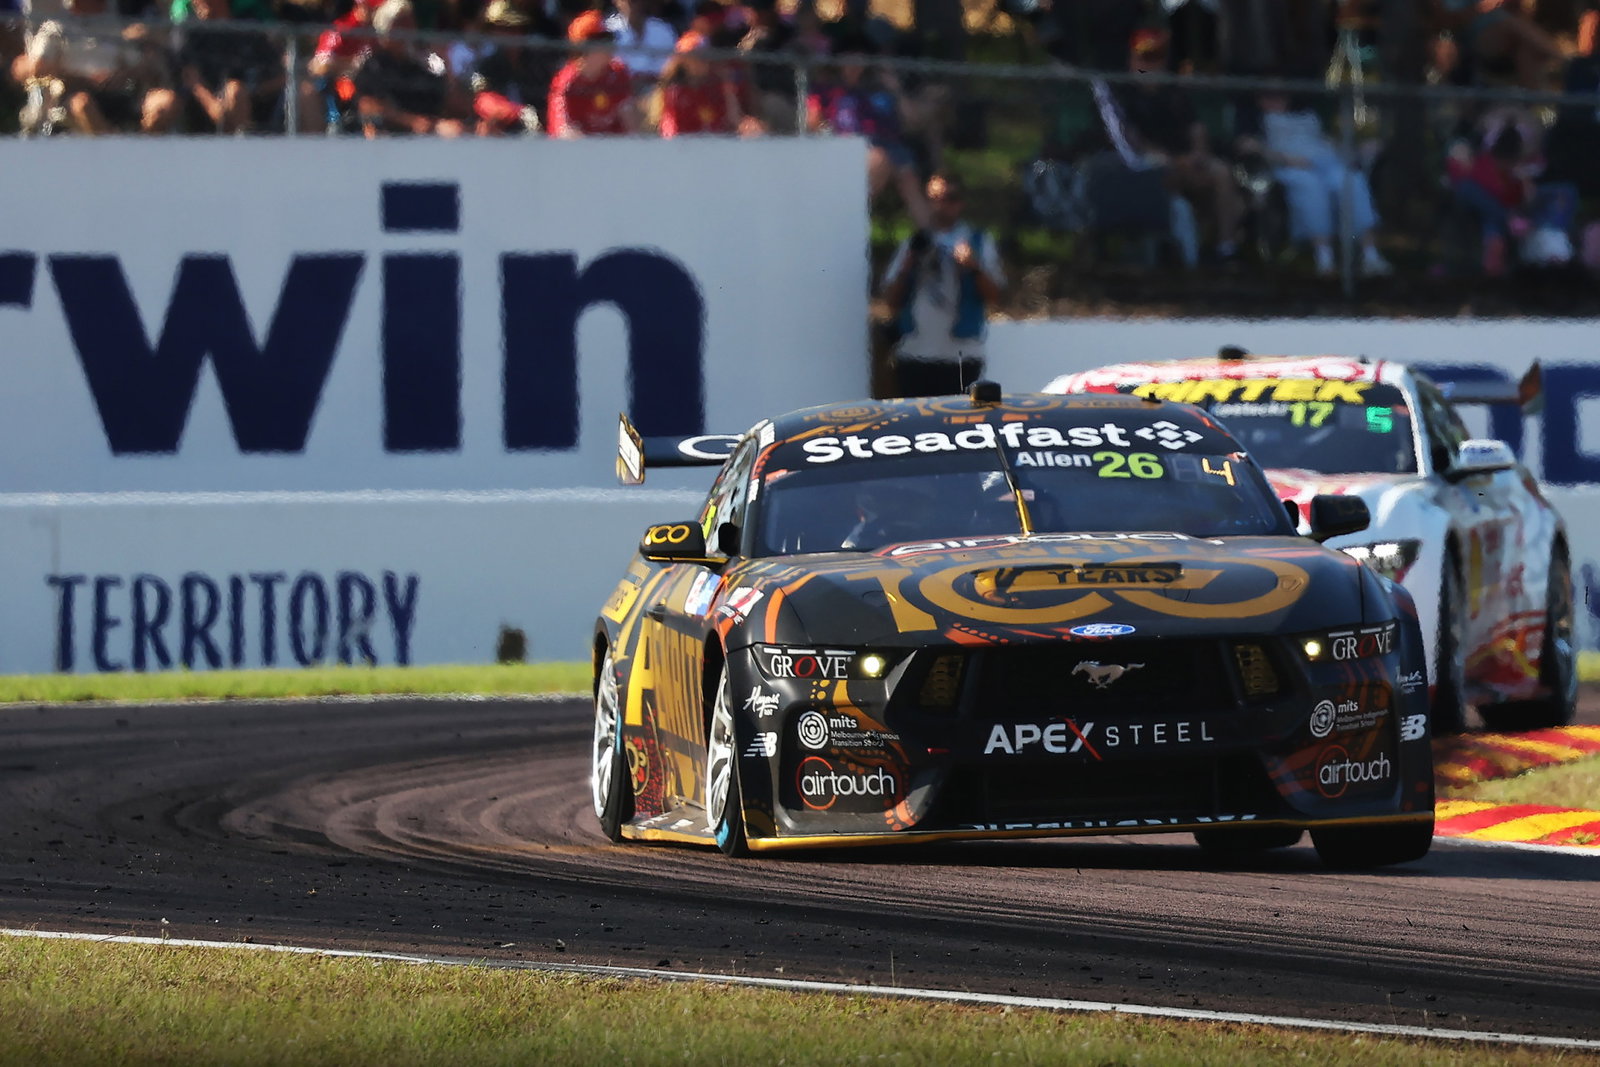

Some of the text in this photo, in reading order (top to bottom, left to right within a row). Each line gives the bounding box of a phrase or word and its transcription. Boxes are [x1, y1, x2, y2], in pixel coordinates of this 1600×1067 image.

[1288, 402, 1335, 428] 17
[1366, 406, 1393, 434] 5
[802, 421, 1132, 463] Steadfast
[1015, 451, 1164, 479] Allen 26
[1201, 457, 1236, 487] 4
[1048, 569, 1176, 584] YEARS
[48, 571, 420, 673] TERRITORY
[1332, 631, 1393, 661] GROVE
[770, 654, 849, 679] GROVE
[1338, 699, 1358, 713] mits
[830, 715, 857, 728] mits
[984, 718, 1215, 761] APEX STEEL
[801, 767, 895, 796] airtouch
[1319, 752, 1391, 785] airtouch
